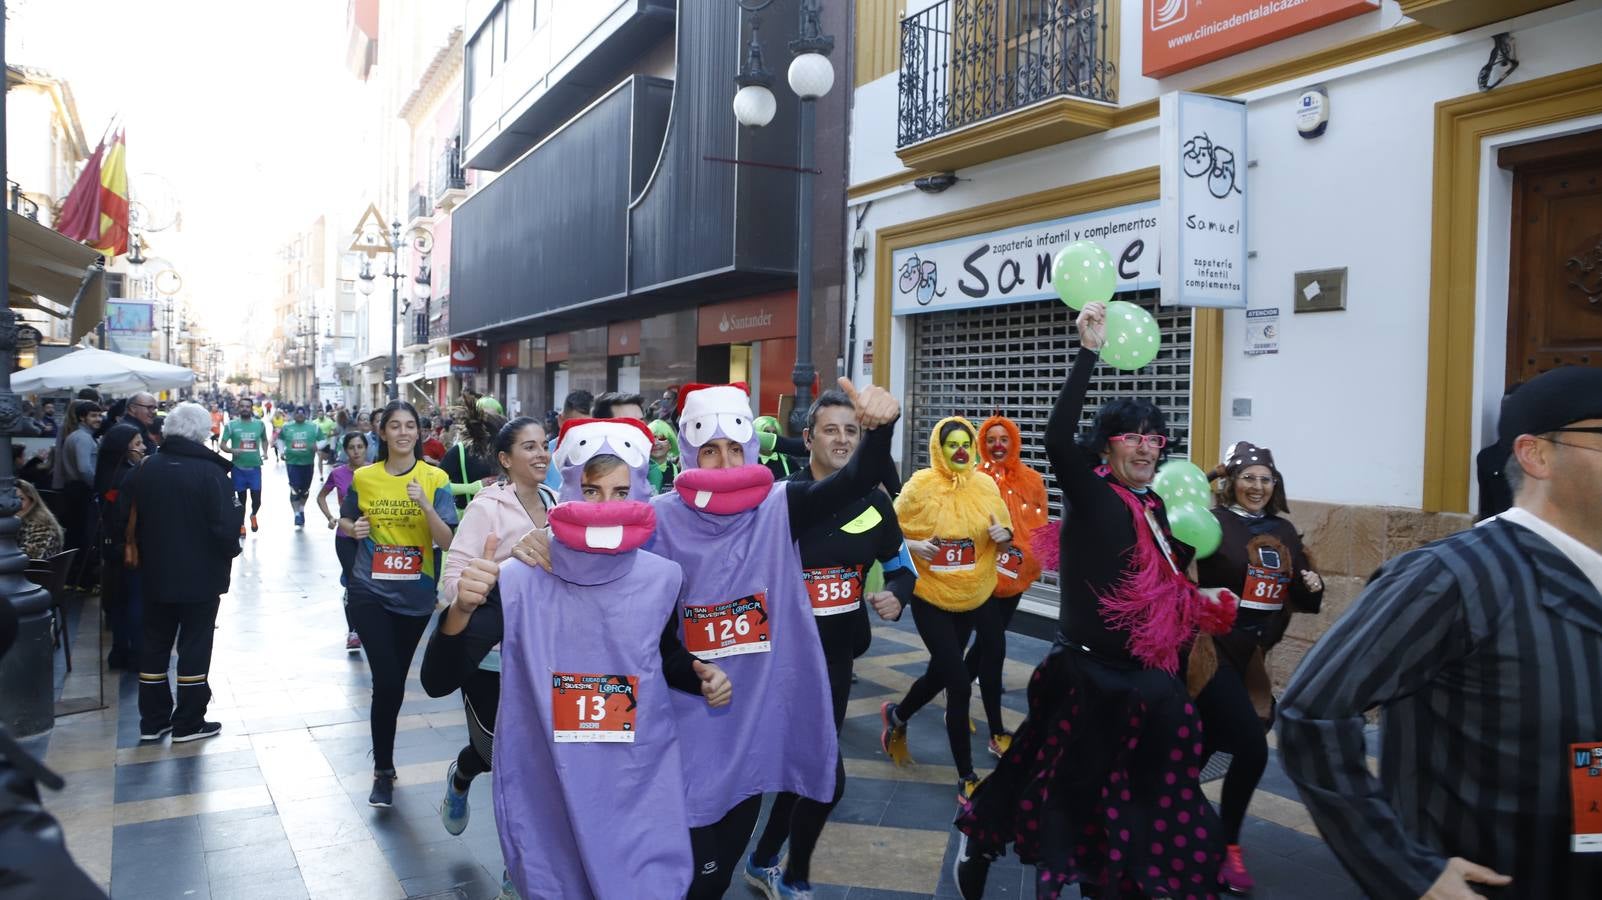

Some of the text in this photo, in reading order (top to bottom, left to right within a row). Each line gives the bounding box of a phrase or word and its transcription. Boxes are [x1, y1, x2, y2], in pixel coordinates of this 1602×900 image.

[1037, 229, 1070, 246] infantil
[1074, 231, 1080, 241] y
[1084, 216, 1157, 239] complementos
[1186, 214, 1240, 234] Samuel
[1198, 268, 1228, 279] infantil
[1185, 280, 1240, 291] complementos
[730, 309, 773, 331] Santander
[946, 548, 962, 562] 61
[383, 556, 413, 570] 462
[817, 580, 851, 602] 358
[1255, 581, 1282, 599] 812
[684, 607, 693, 618] VI
[697, 610, 727, 619] SILVESTRE
[732, 601, 762, 615] LORCA
[704, 614, 751, 643] 126
[553, 676, 560, 688] VI
[599, 684, 632, 694] LORCA
[576, 695, 606, 721] 13
[1576, 750, 1591, 767] VI
